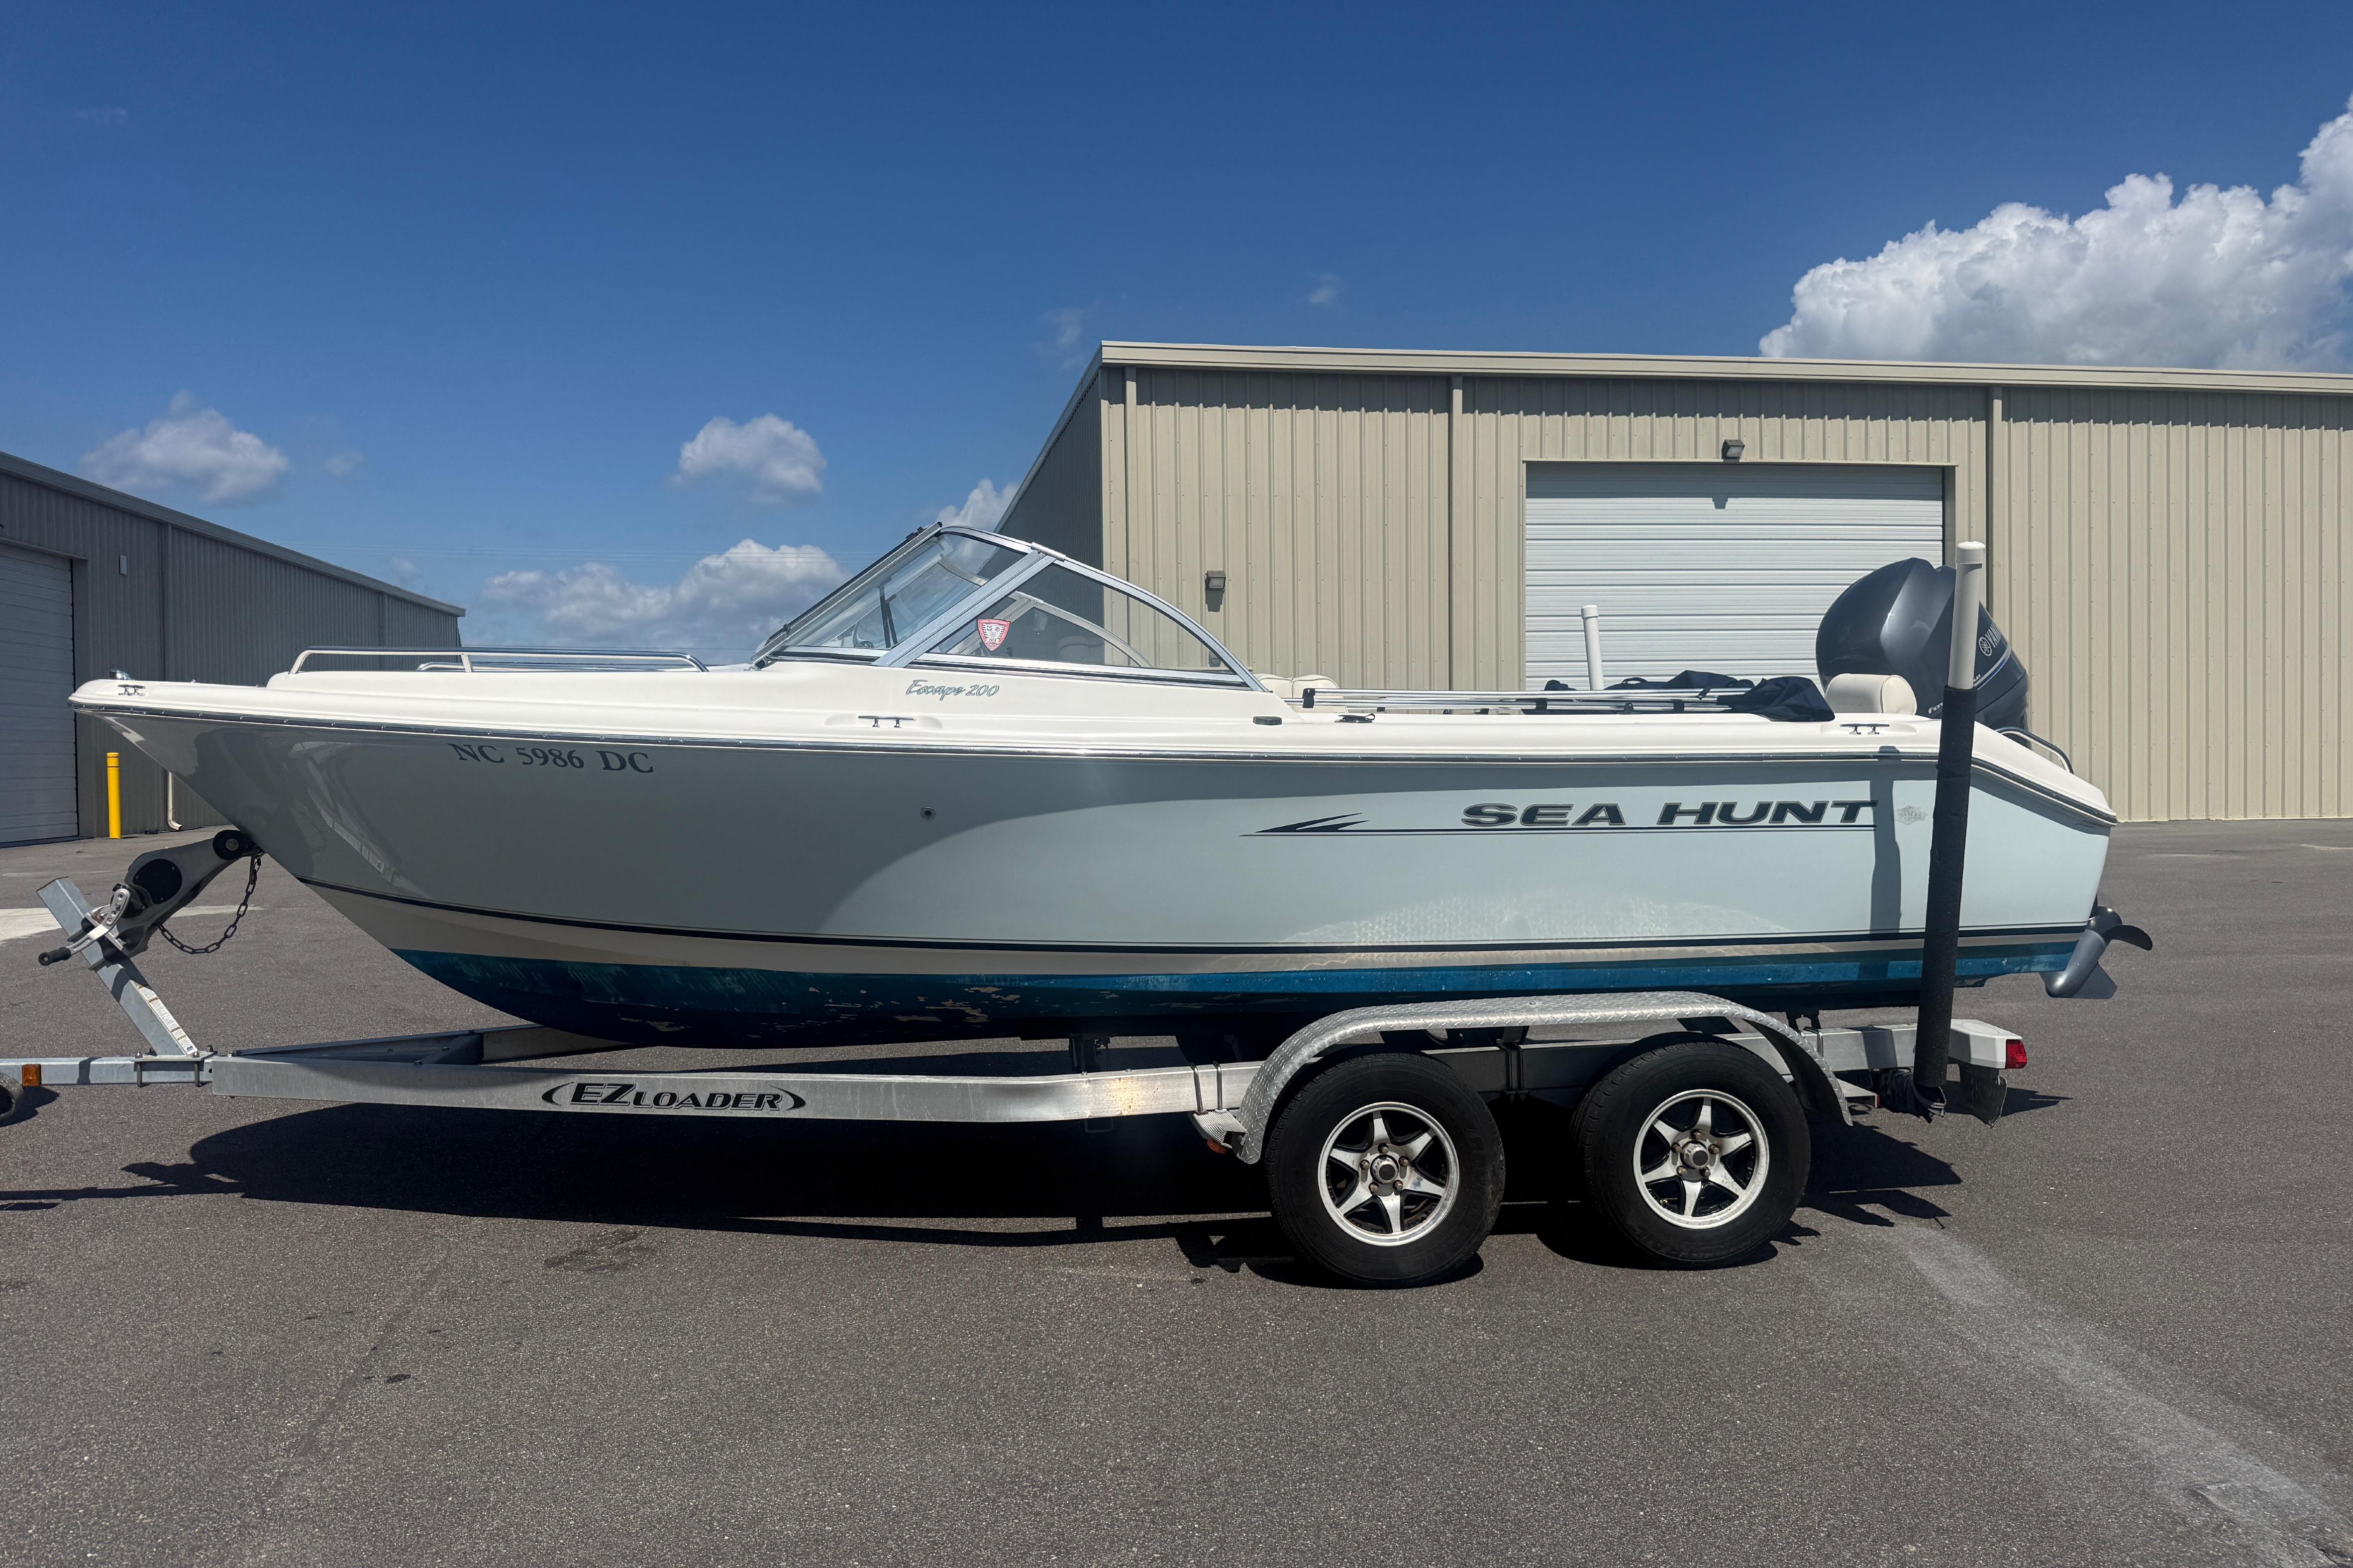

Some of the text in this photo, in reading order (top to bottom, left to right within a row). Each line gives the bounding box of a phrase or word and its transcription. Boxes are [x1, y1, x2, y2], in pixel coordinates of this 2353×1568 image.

[906, 679, 1000, 701] Escape 200
[447, 743, 654, 774] NC 5986 DC
[1461, 803, 1626, 826] SEA
[1656, 799, 1879, 825] HUNT
